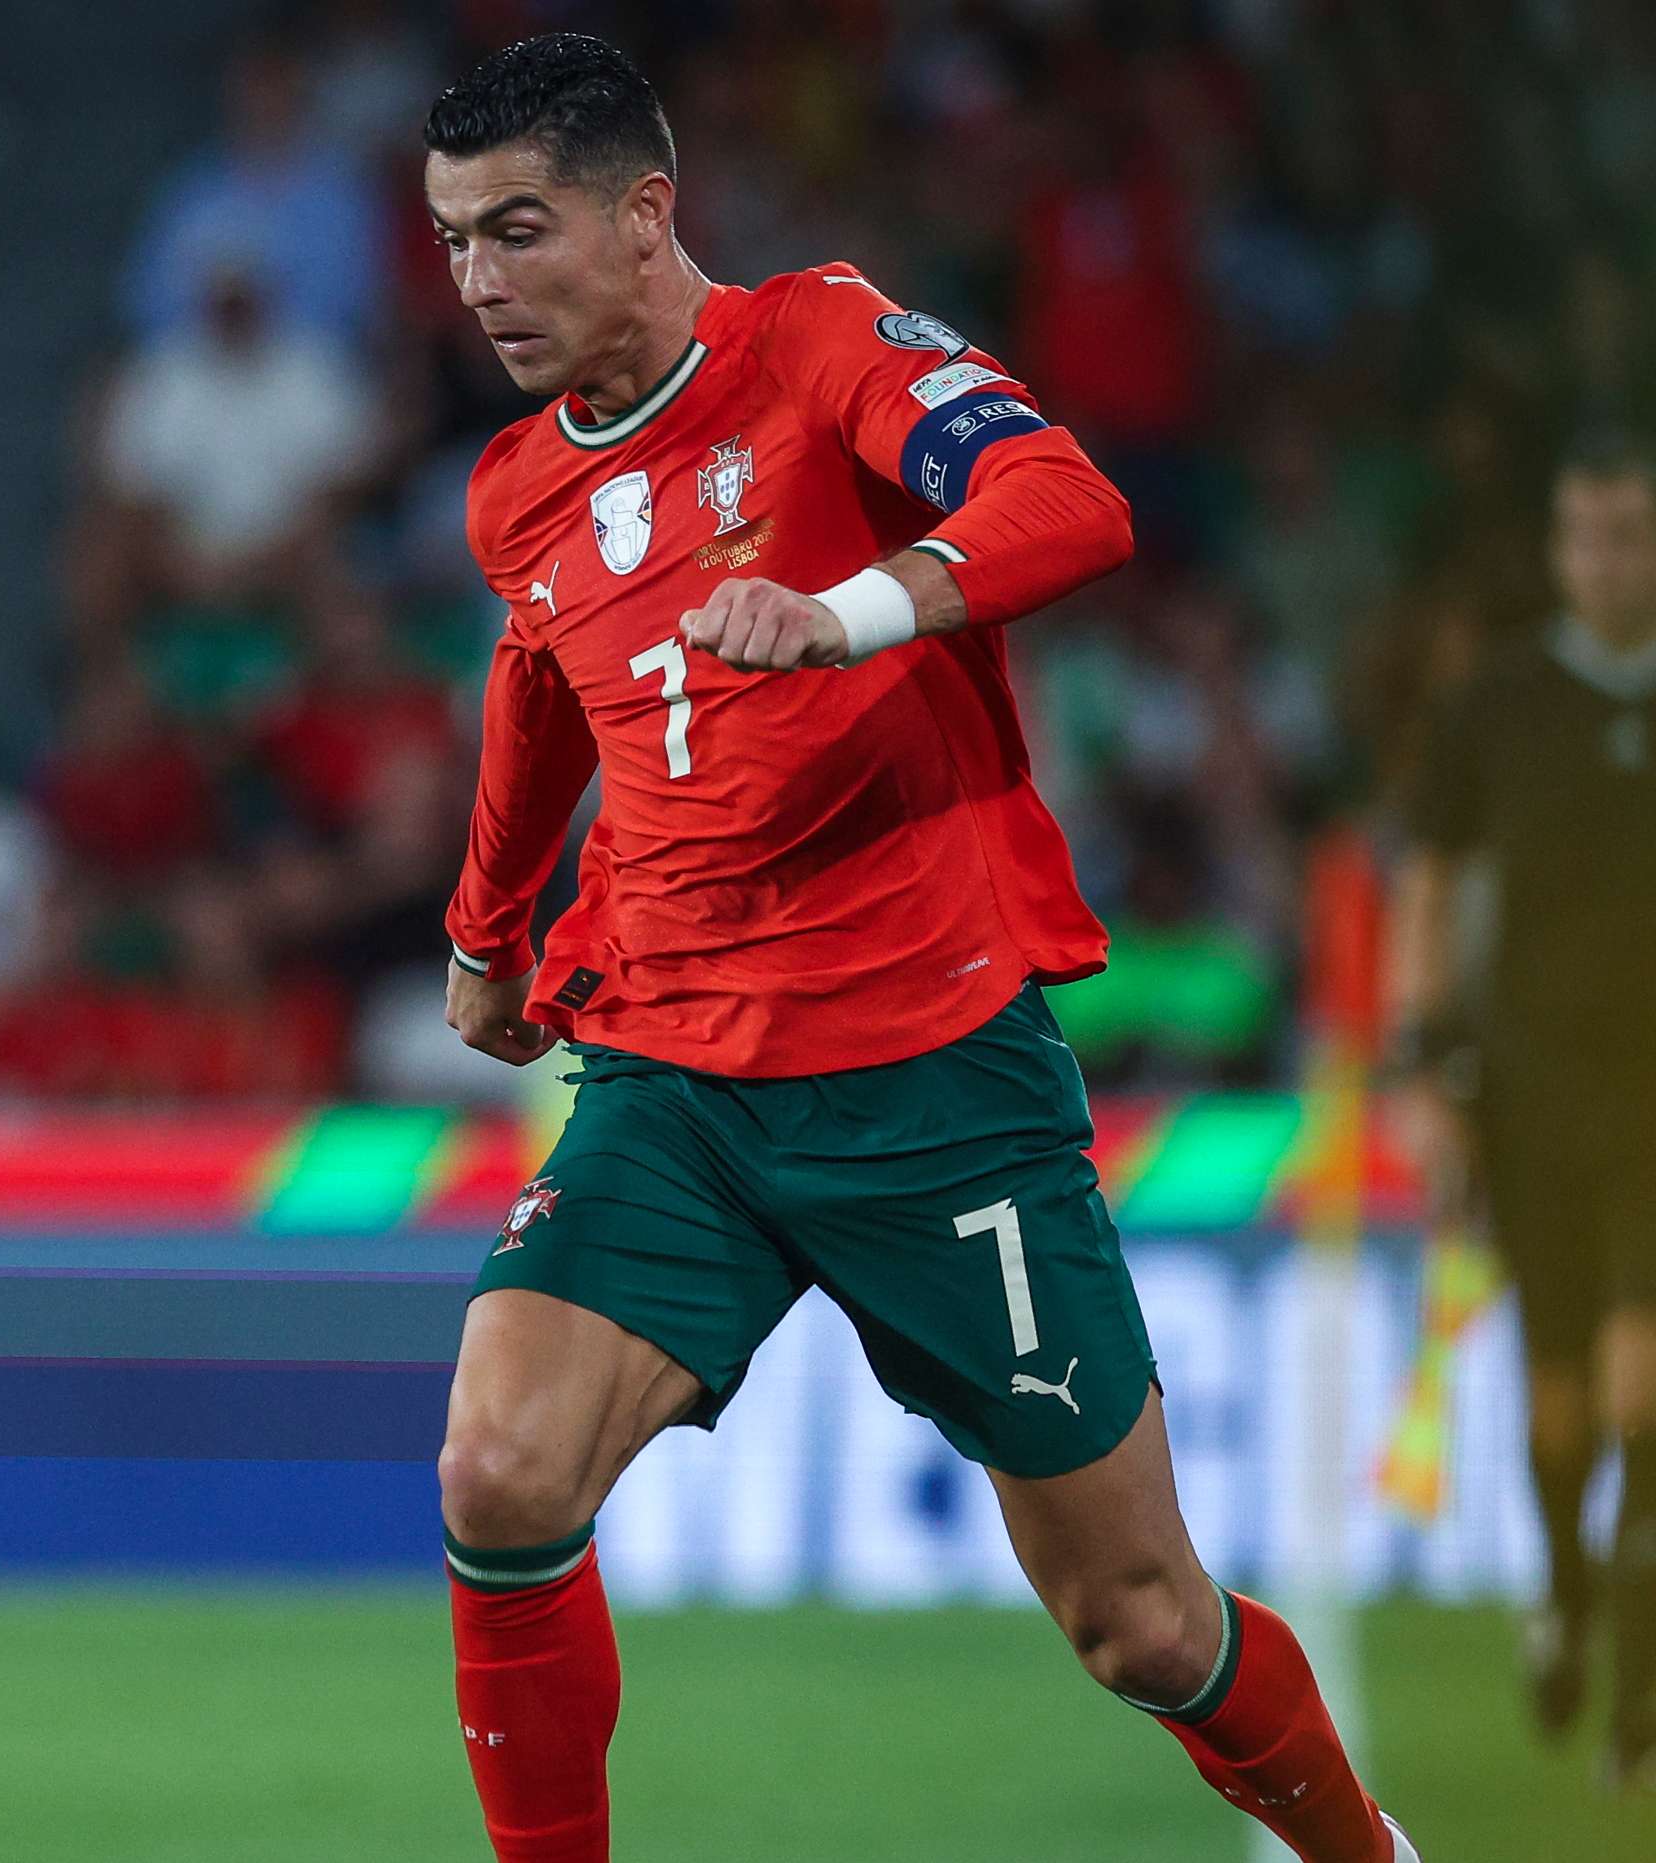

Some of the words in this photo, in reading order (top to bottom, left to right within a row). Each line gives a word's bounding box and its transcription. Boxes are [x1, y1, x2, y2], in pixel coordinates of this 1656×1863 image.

[913, 378, 932, 393] UEFA
[709, 538, 753, 566] OUTUBRO
[727, 548, 759, 570] LISBOA
[628, 636, 692, 779] 7
[952, 1197, 1040, 1357] 7
